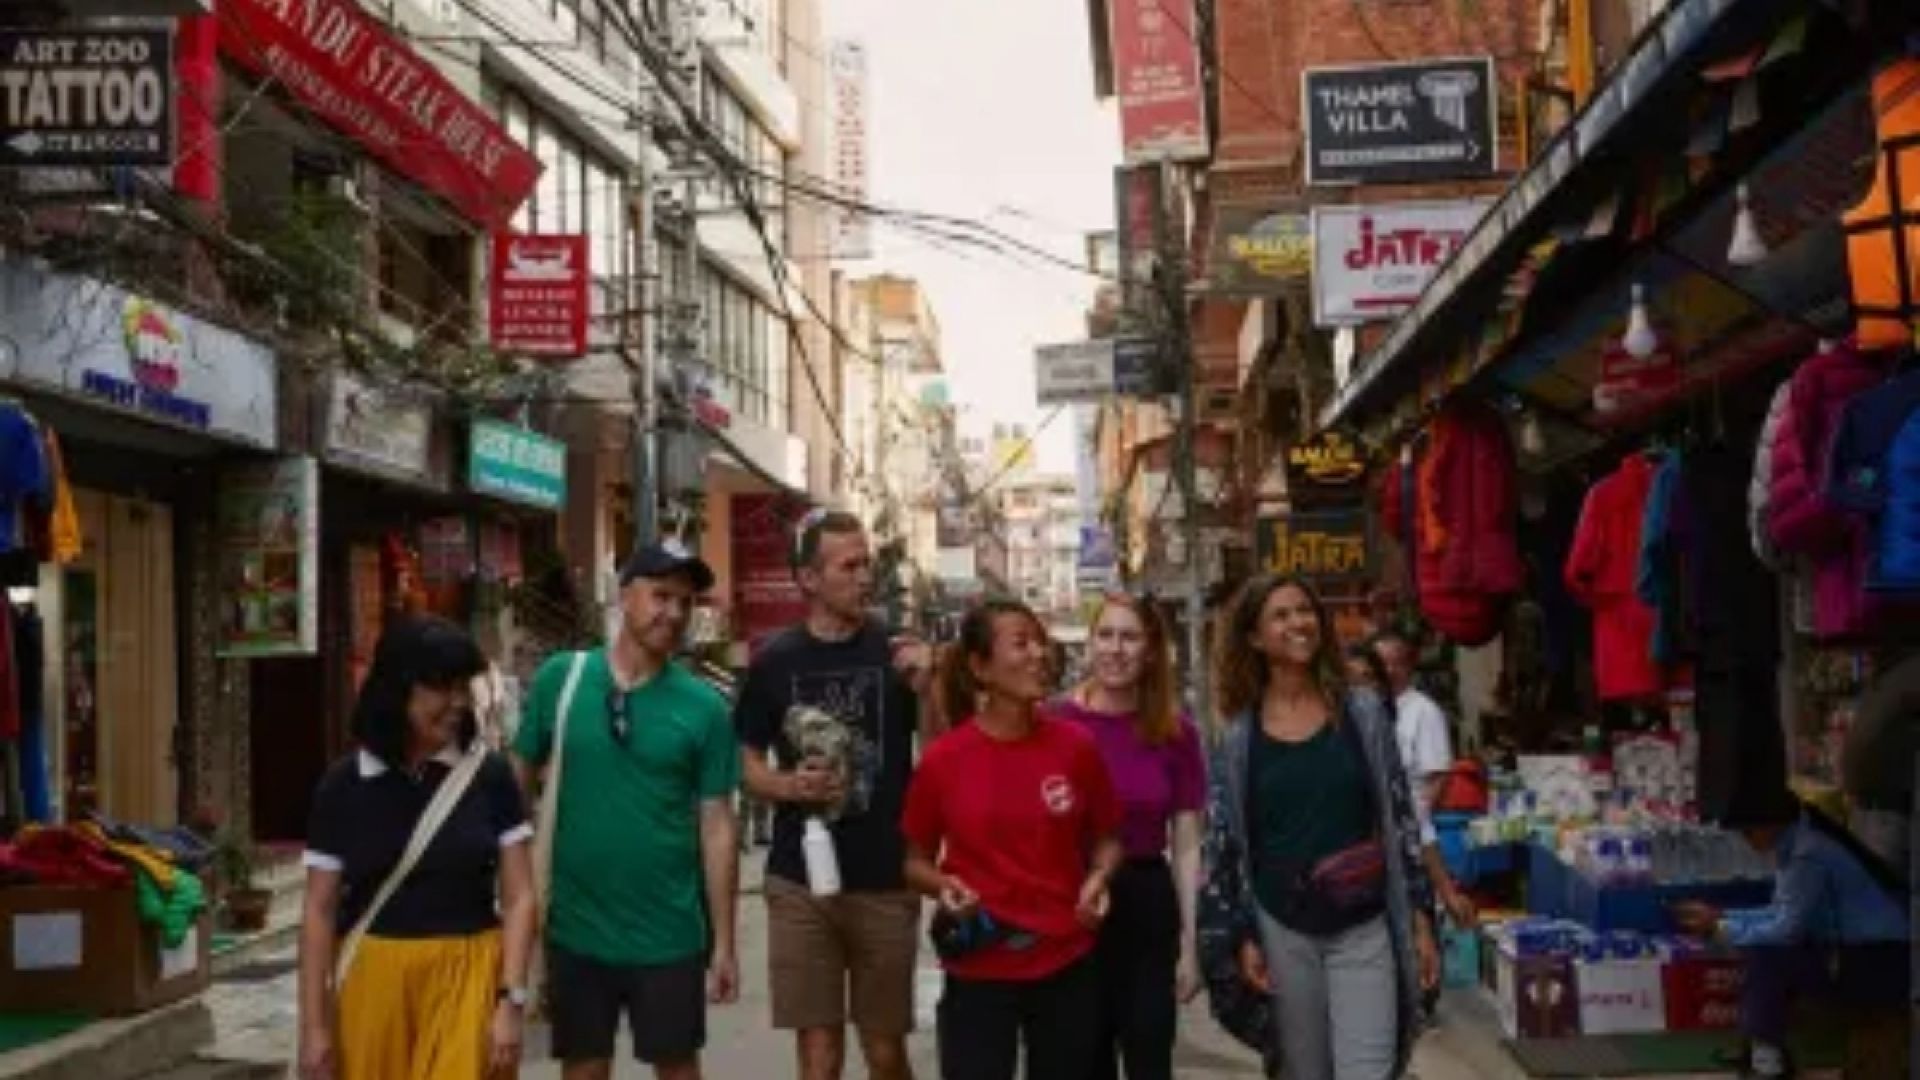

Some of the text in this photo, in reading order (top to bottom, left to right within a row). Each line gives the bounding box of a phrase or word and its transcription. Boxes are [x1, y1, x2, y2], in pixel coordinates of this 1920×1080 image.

[14, 37, 150, 62] ART ZOO
[2, 68, 163, 126] TATTOO
[362, 45, 443, 134] STEAK
[1319, 84, 1416, 109] THAMEL
[1328, 109, 1408, 136] VILLA
[1263, 521, 1364, 577] JATRA
